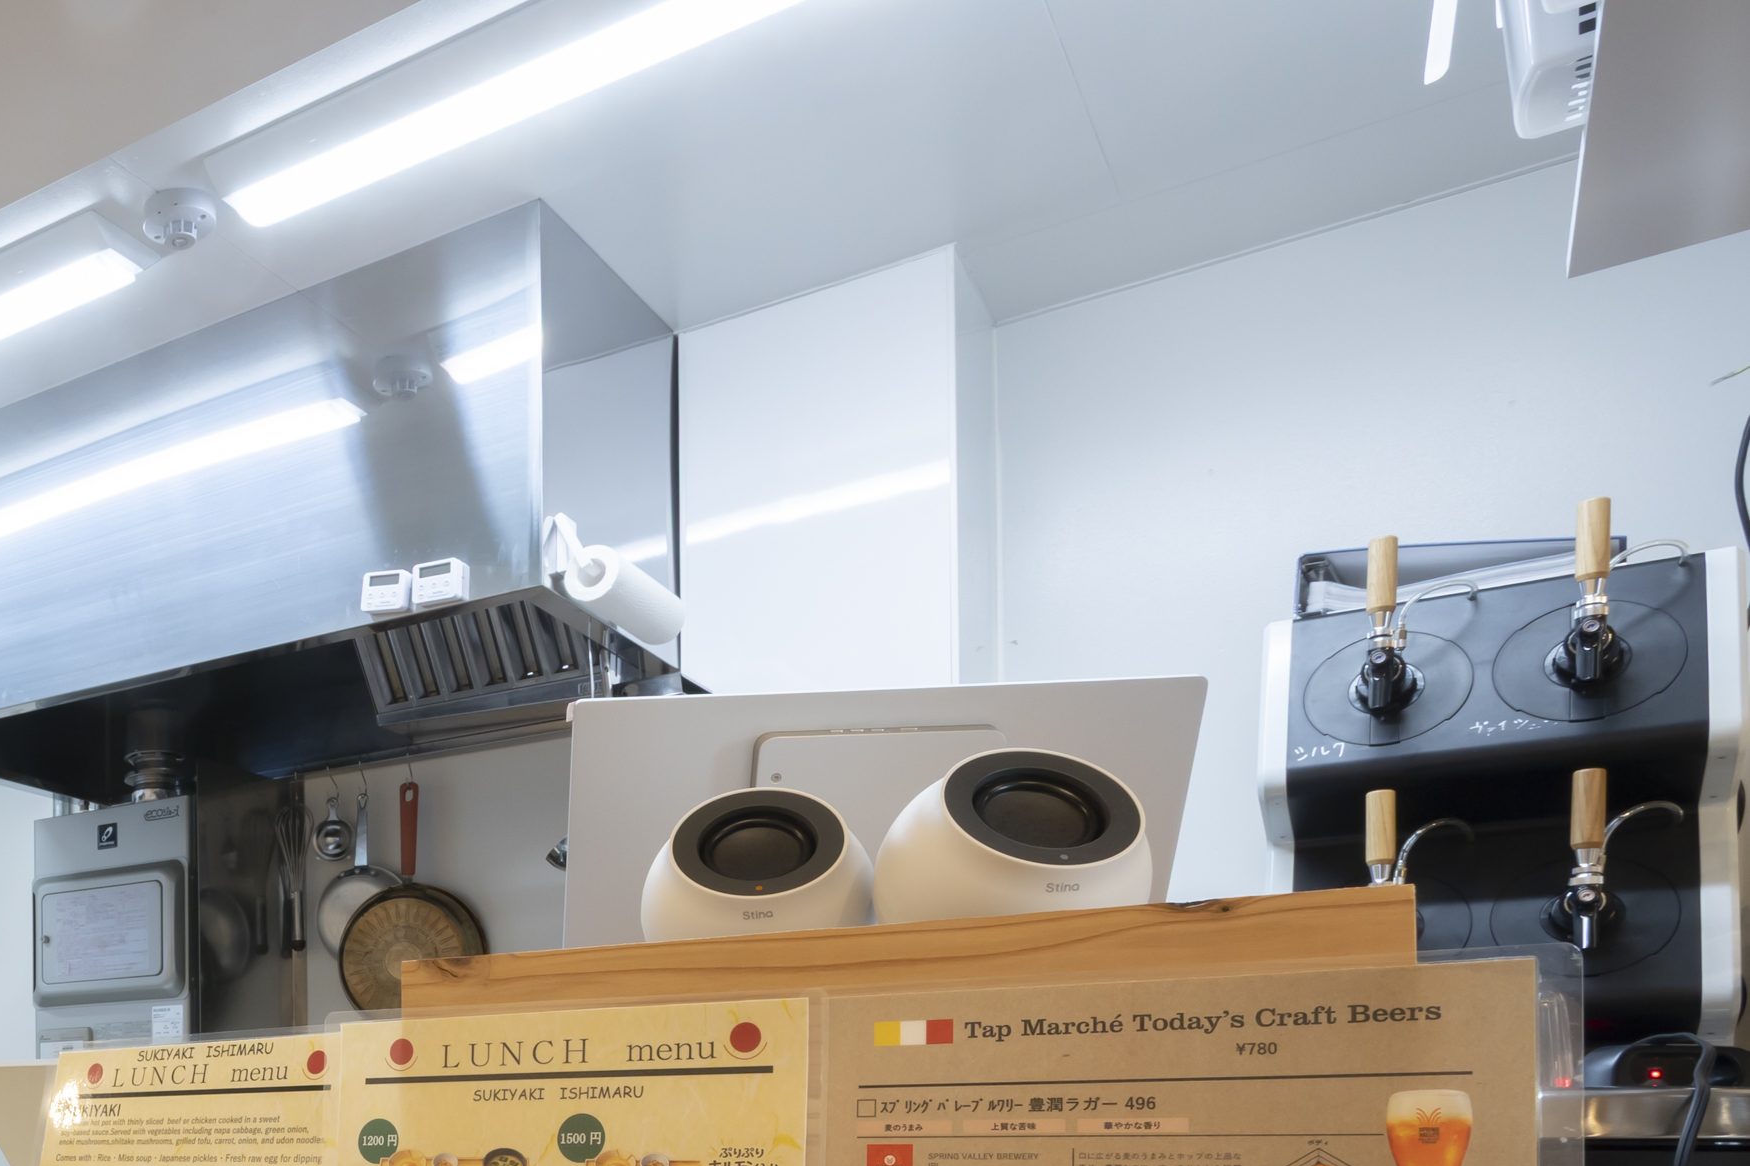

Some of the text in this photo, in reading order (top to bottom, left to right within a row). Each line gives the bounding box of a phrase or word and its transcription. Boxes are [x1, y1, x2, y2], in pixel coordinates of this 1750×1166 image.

[965, 1002, 1442, 1041] Tap Marché Today's Craft Beers
[137, 1042, 274, 1062] SUKIYAKI ISHIMARU
[441, 1038, 717, 1069] LUNCH menu
[1236, 1042, 1278, 1056] ¥780
[112, 1064, 288, 1087] LUNCH menu
[473, 1085, 644, 1102] SUKIYAKI ISHIMARU
[1124, 1096, 1156, 1110] 496
[884, 1123, 923, 1132] 麦のうまみ
[991, 1121, 1036, 1131] 上質な苦味
[1103, 1120, 1161, 1131] 華やかな香り
[719, 1147, 764, 1159] ぷりぷり
[928, 1152, 1039, 1161] SPRING VALLEY BREWERY
